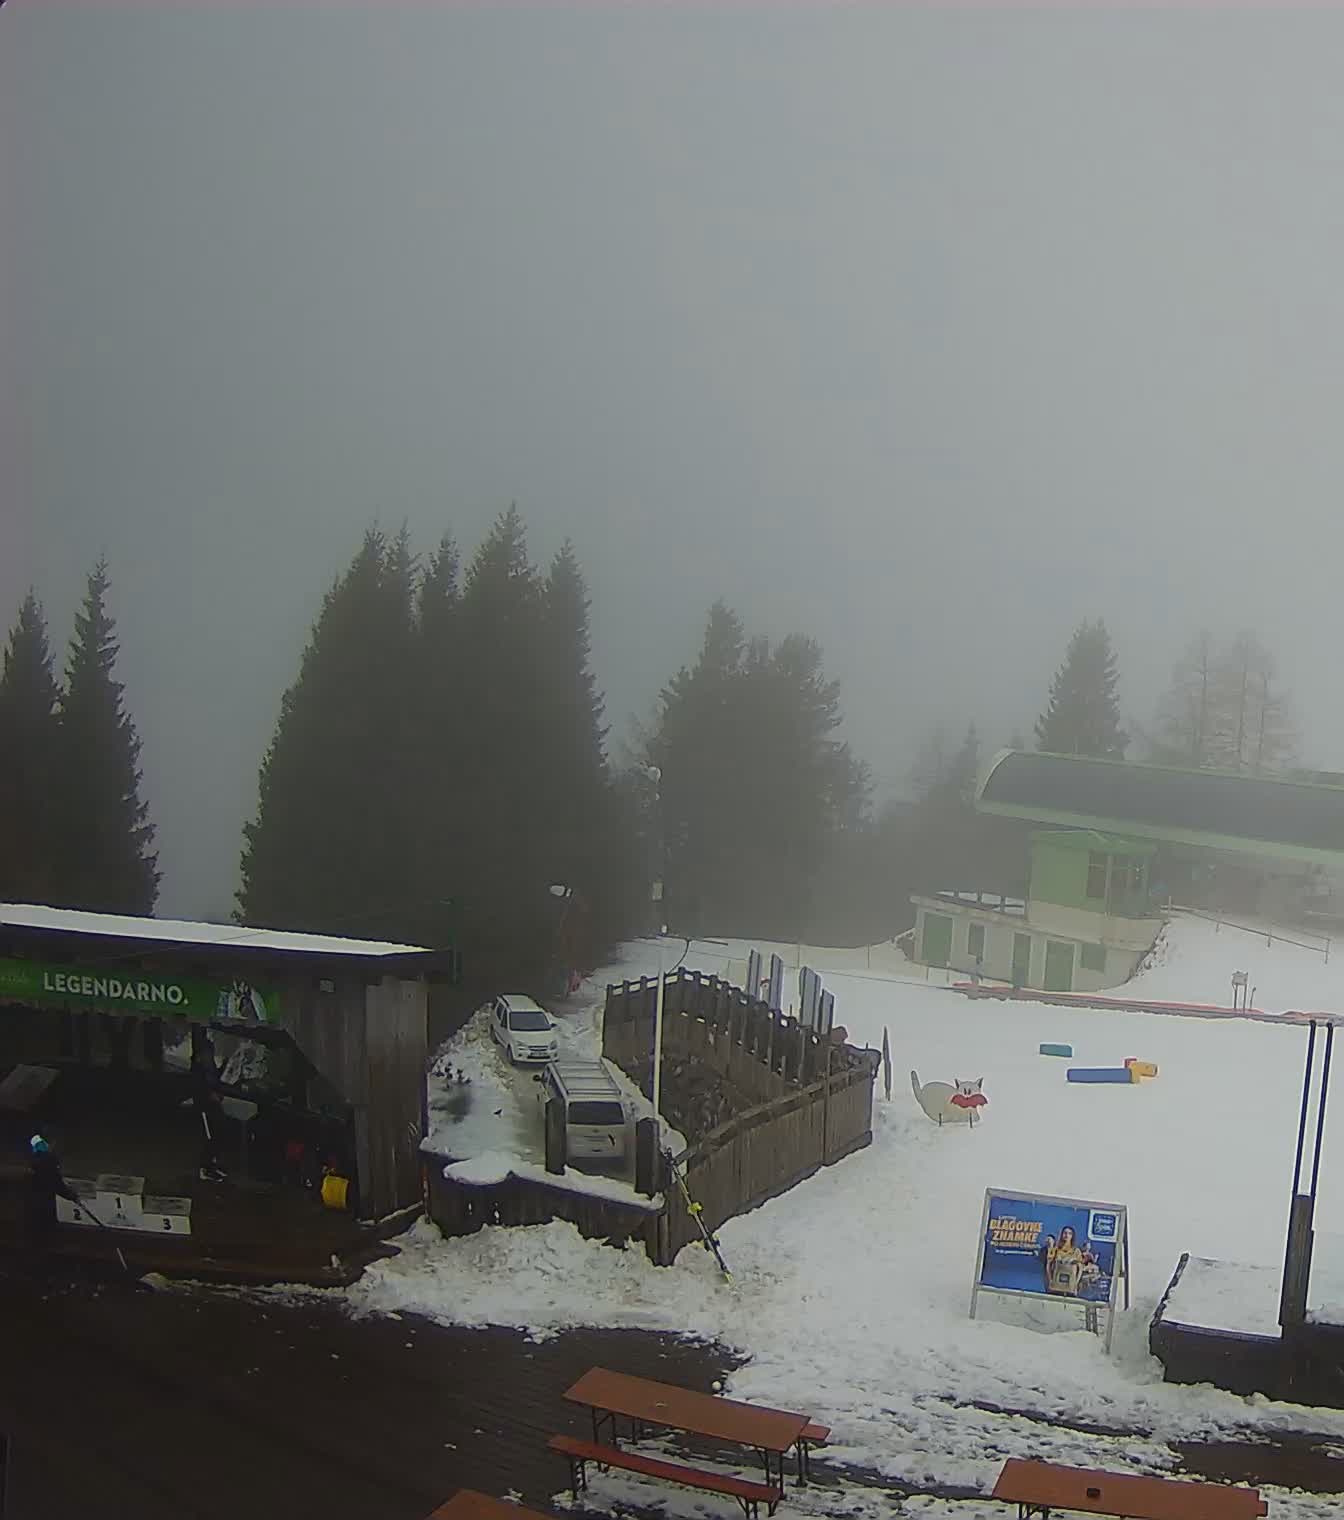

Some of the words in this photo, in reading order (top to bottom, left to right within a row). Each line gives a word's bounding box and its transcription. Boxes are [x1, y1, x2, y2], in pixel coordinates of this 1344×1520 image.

[43, 971, 190, 1005] LEGENDARNO.
[115, 1196, 122, 1209] 1
[73, 1208, 82, 1221] 2
[163, 1218, 172, 1231] 3
[992, 1230, 1039, 1243] ZNAMKE
